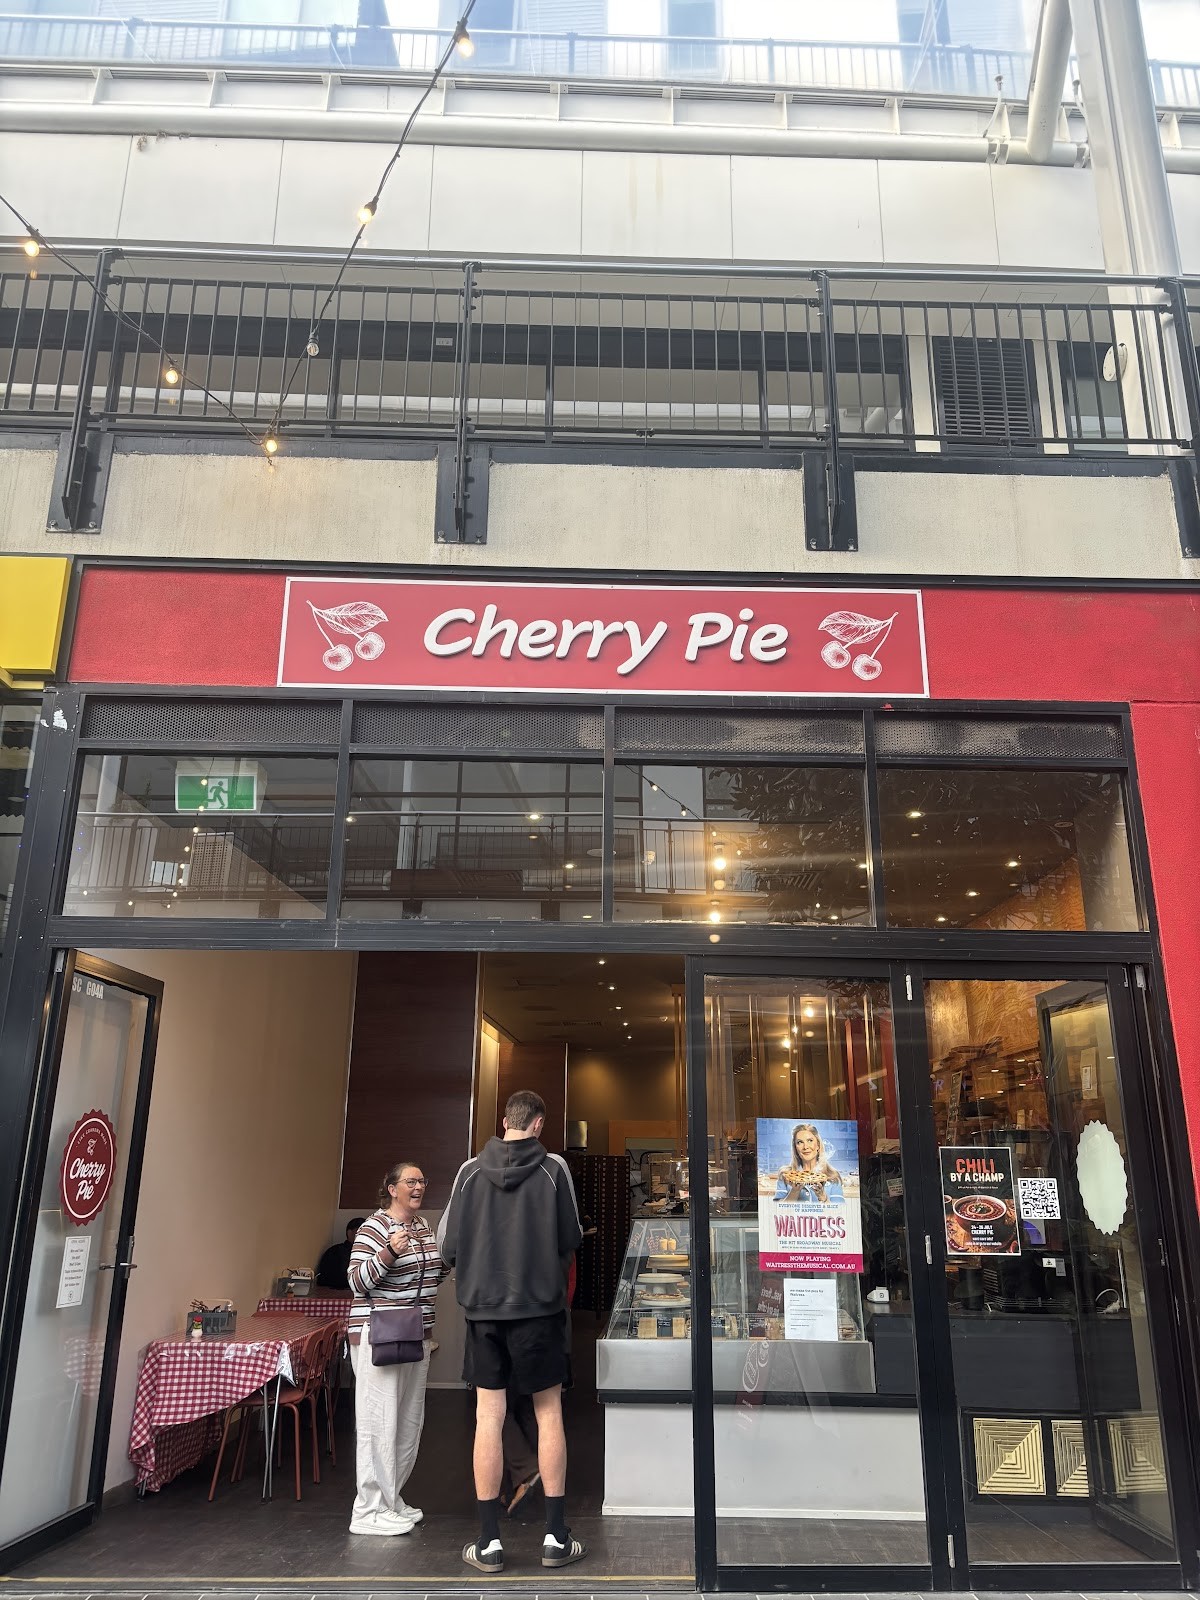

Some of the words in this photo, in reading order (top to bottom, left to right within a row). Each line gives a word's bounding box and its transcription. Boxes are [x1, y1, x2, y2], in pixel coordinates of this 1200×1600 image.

[422, 603, 668, 676] Cherry
[684, 607, 789, 663] Pie
[70, 1157, 106, 1185] Cherry
[950, 1172, 963, 1183] BY
[964, 1172, 972, 1183] A
[973, 1172, 1005, 1183] CHAMP
[956, 1158, 996, 1174] CHILI
[75, 1179, 95, 1202] Pie
[773, 1214, 847, 1239] WAITRESS
[805, 1255, 832, 1263] PLAYING
